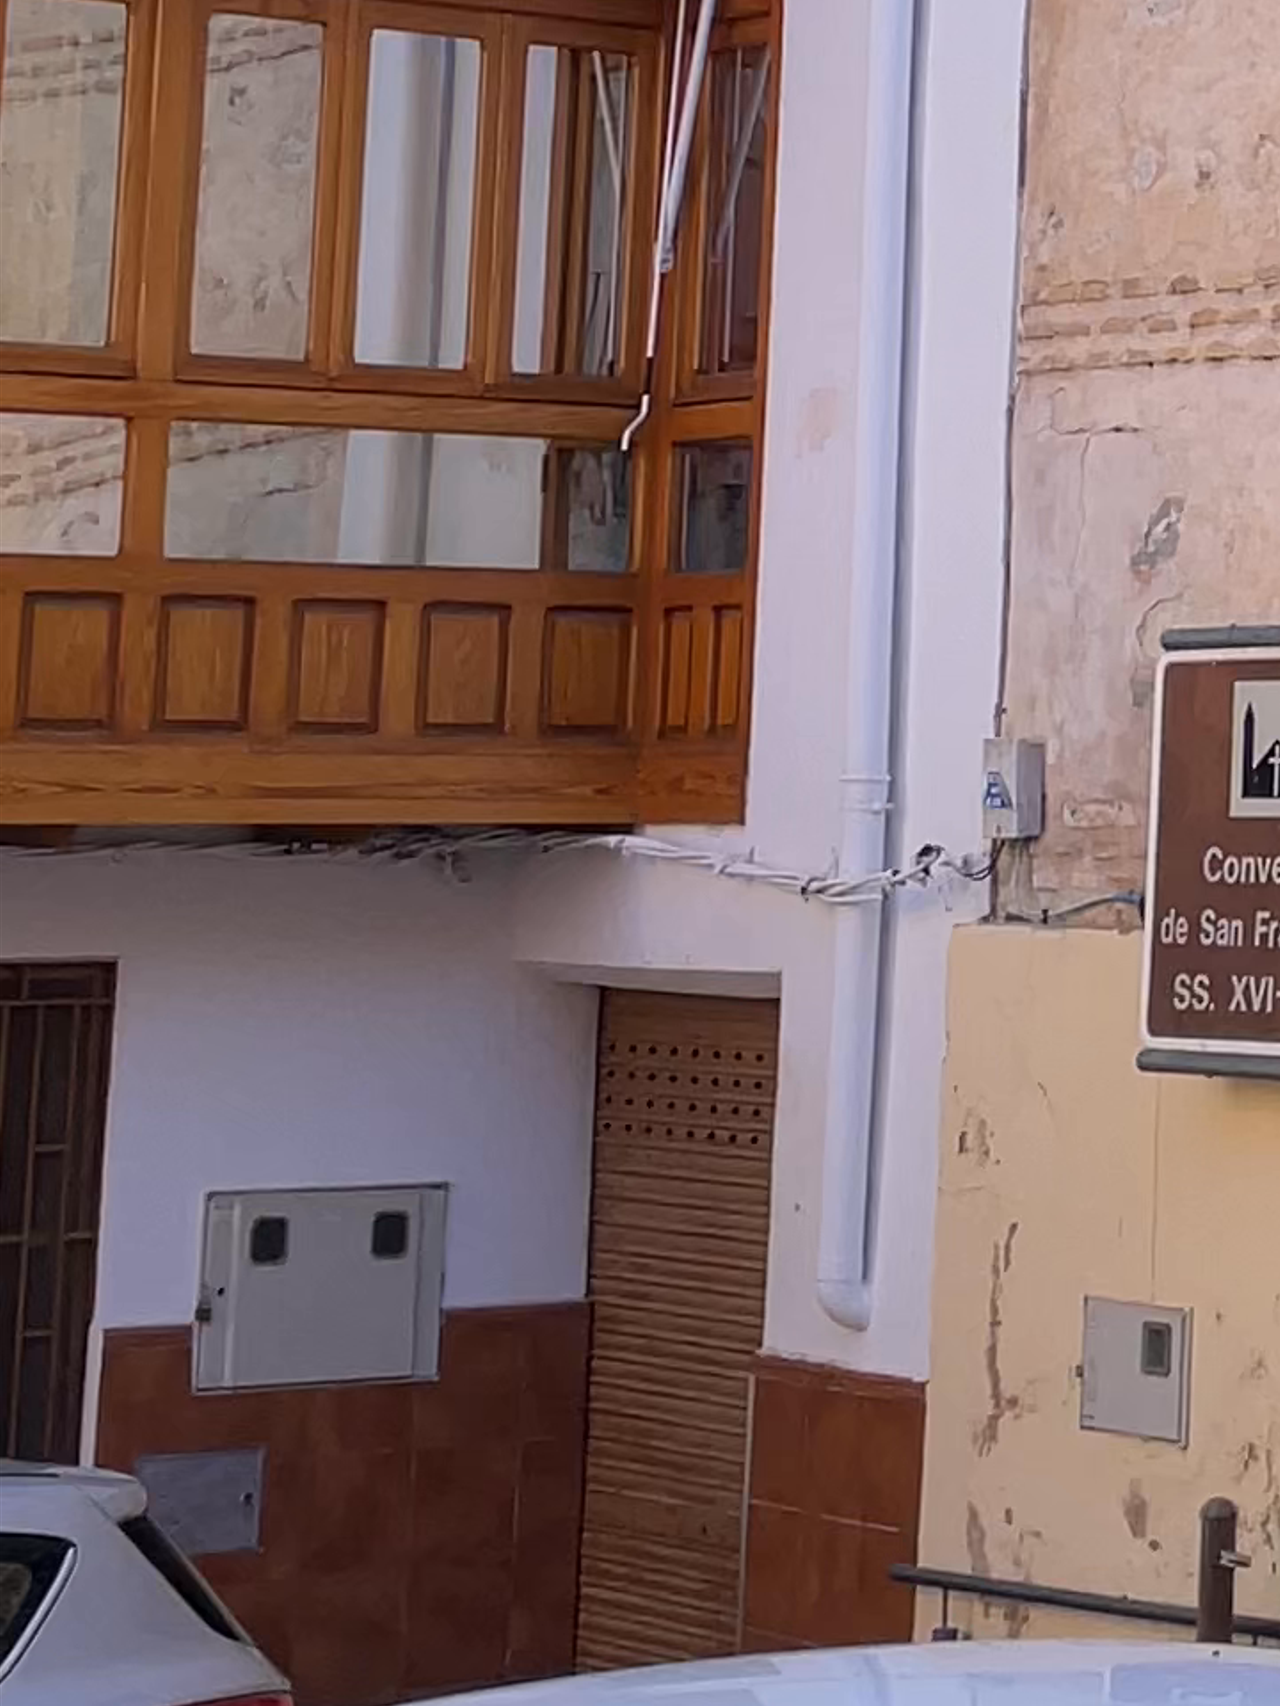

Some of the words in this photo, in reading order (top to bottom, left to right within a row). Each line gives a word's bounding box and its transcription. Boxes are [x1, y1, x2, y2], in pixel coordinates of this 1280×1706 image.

[1160, 907, 1189, 945] de
[1199, 908, 1244, 947] San
[1172, 972, 1215, 1012] SS.
